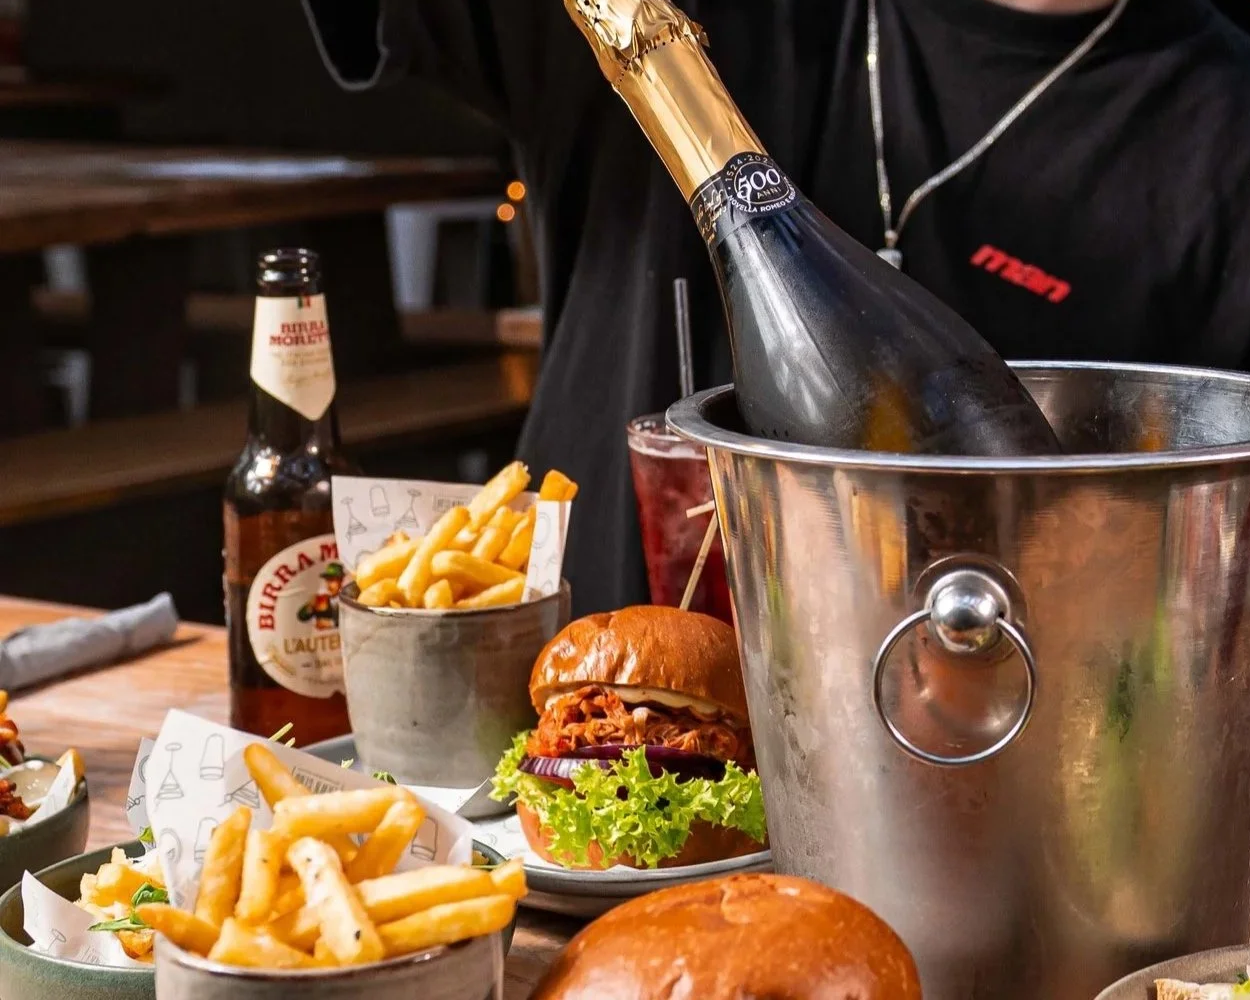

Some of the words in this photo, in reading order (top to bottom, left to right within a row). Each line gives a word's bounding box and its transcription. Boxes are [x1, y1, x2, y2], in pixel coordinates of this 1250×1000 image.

[737, 168, 780, 208] 500
[757, 187, 782, 200] ANNI
[727, 194, 758, 213] NOVELLA
[760, 200, 786, 212] ROMEO
[259, 552, 314, 631] BIRRA
